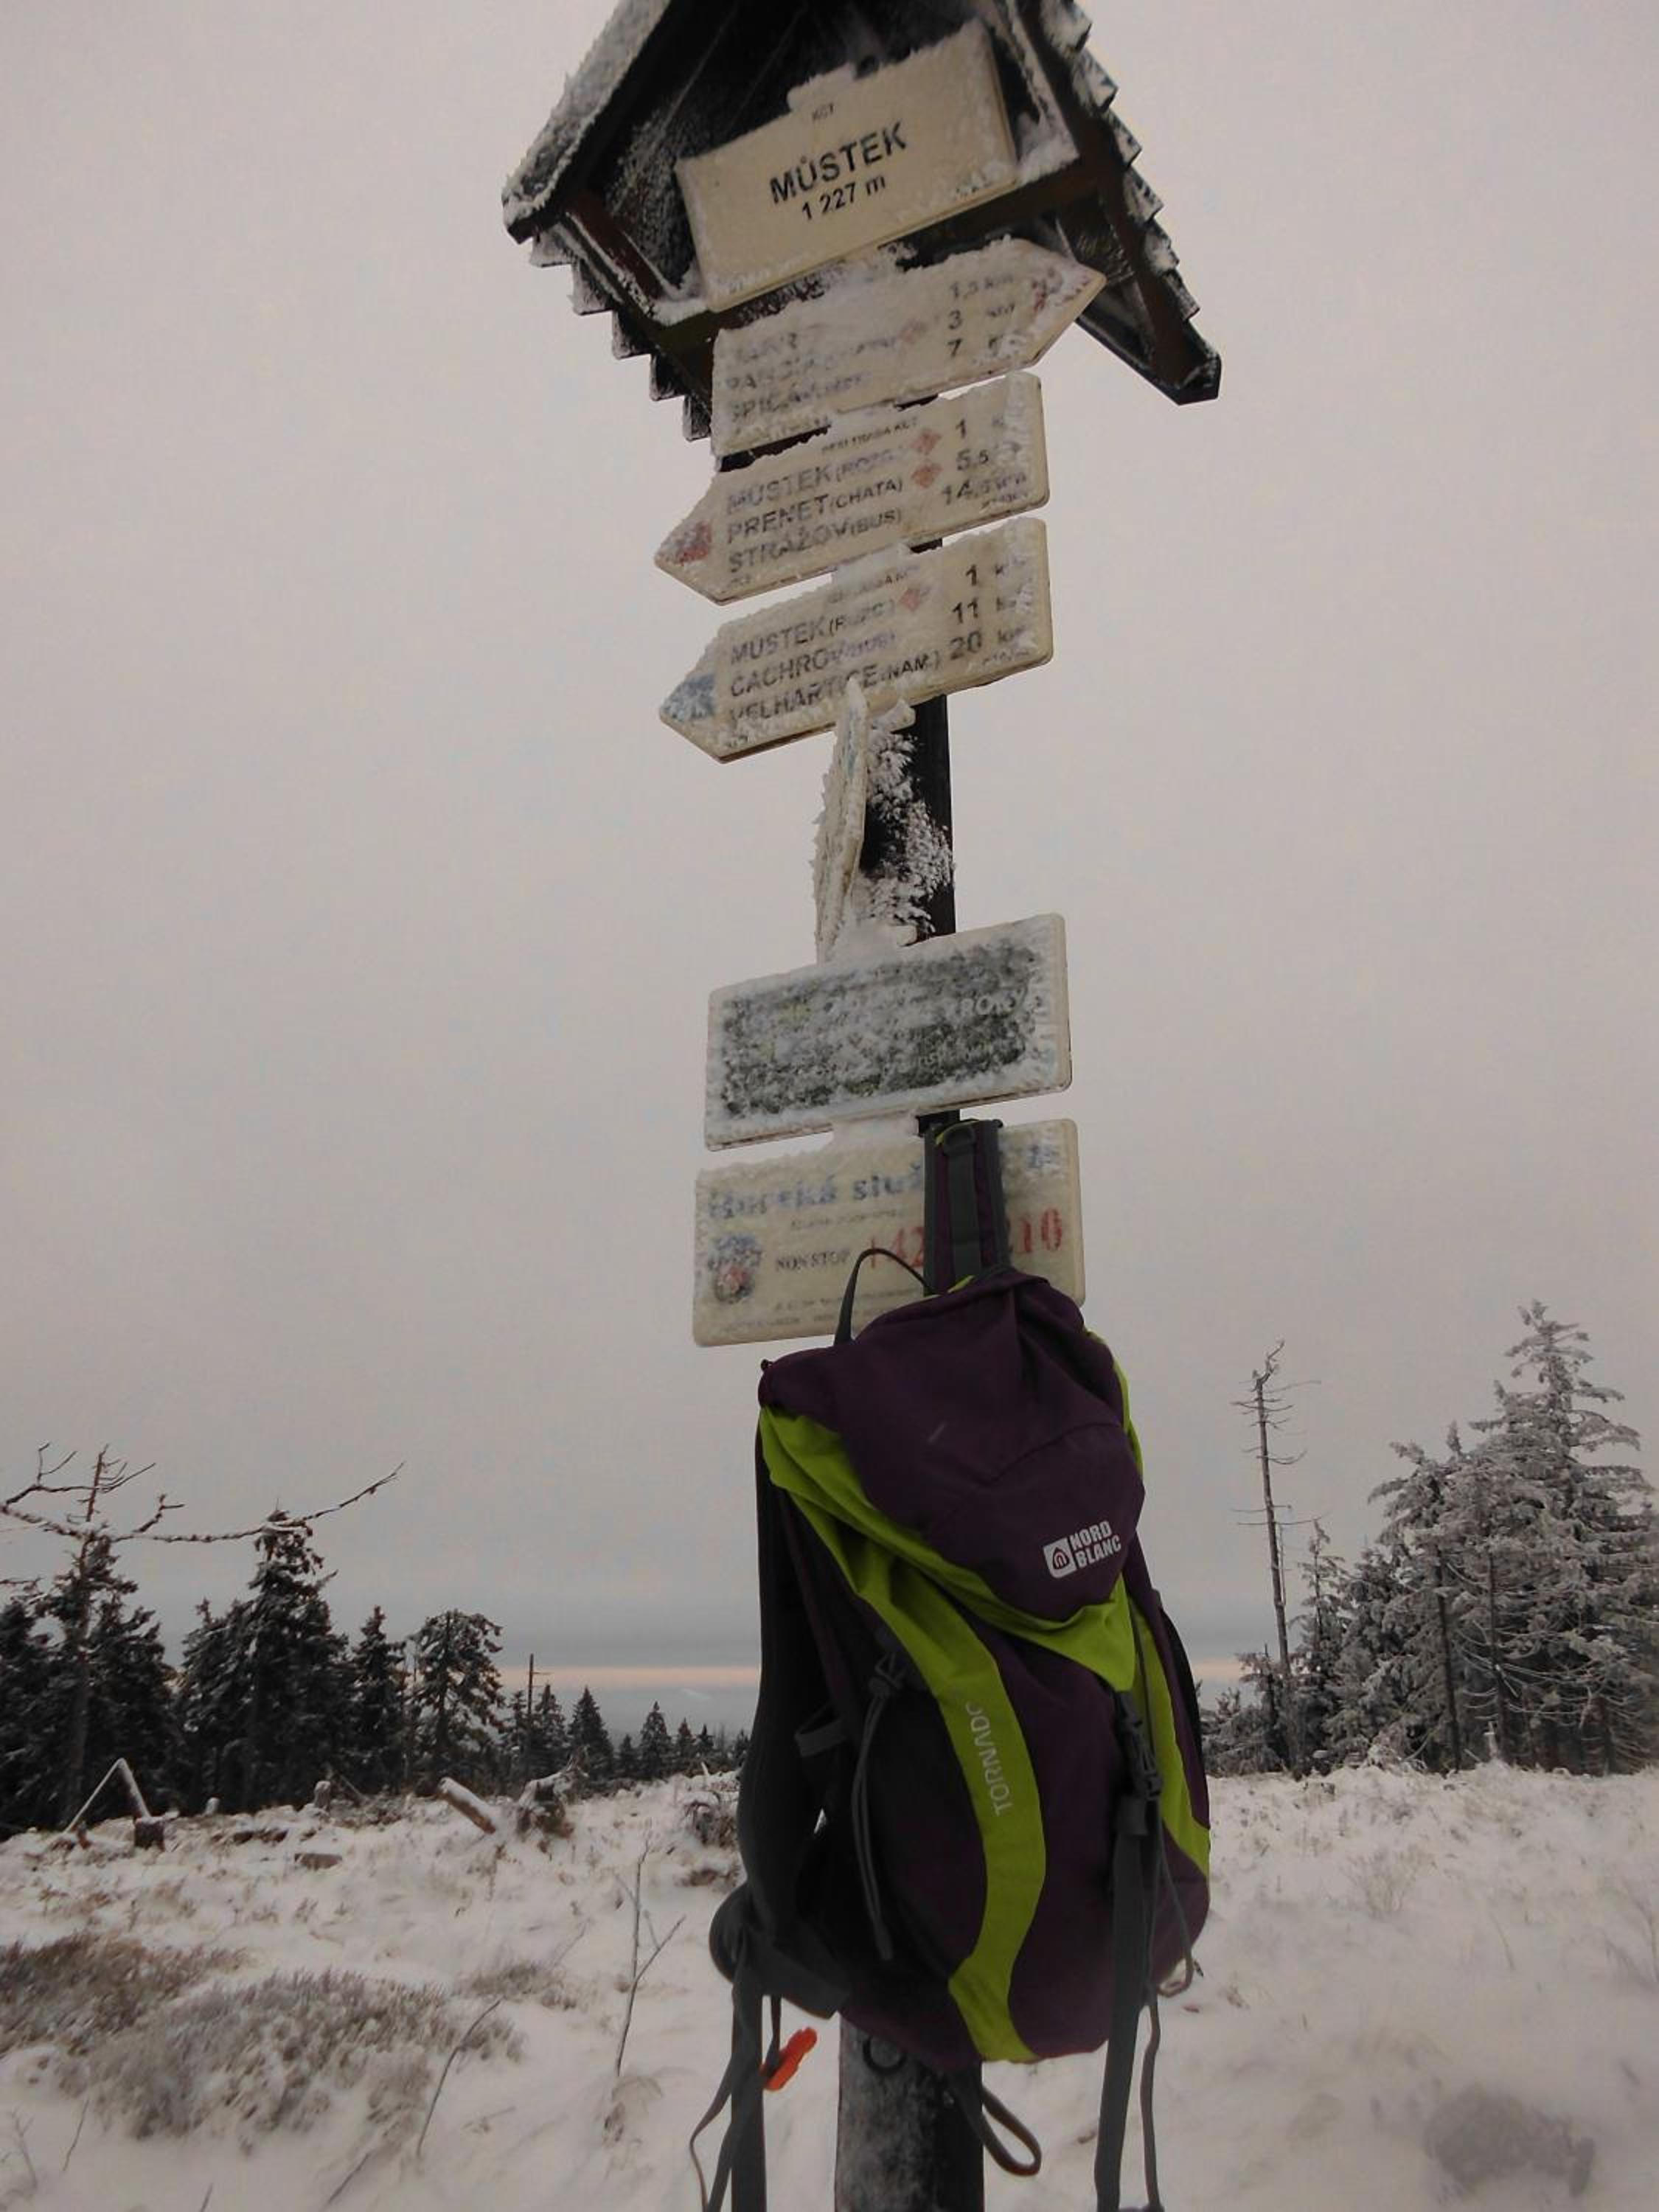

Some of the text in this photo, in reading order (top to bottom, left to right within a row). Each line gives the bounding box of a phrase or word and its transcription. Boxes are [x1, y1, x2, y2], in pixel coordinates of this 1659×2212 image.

[769, 121, 908, 204] MŮSTEK
[802, 175, 886, 222] 1 227 m
[947, 308, 964, 331] 3
[946, 336, 964, 359] 7
[955, 417, 967, 440] 1
[964, 563, 978, 587] 1
[950, 596, 979, 625] 11
[948, 627, 983, 661] 20
[1068, 1520, 1113, 1551] NORD
[1074, 1534, 1122, 1569] BLANC
